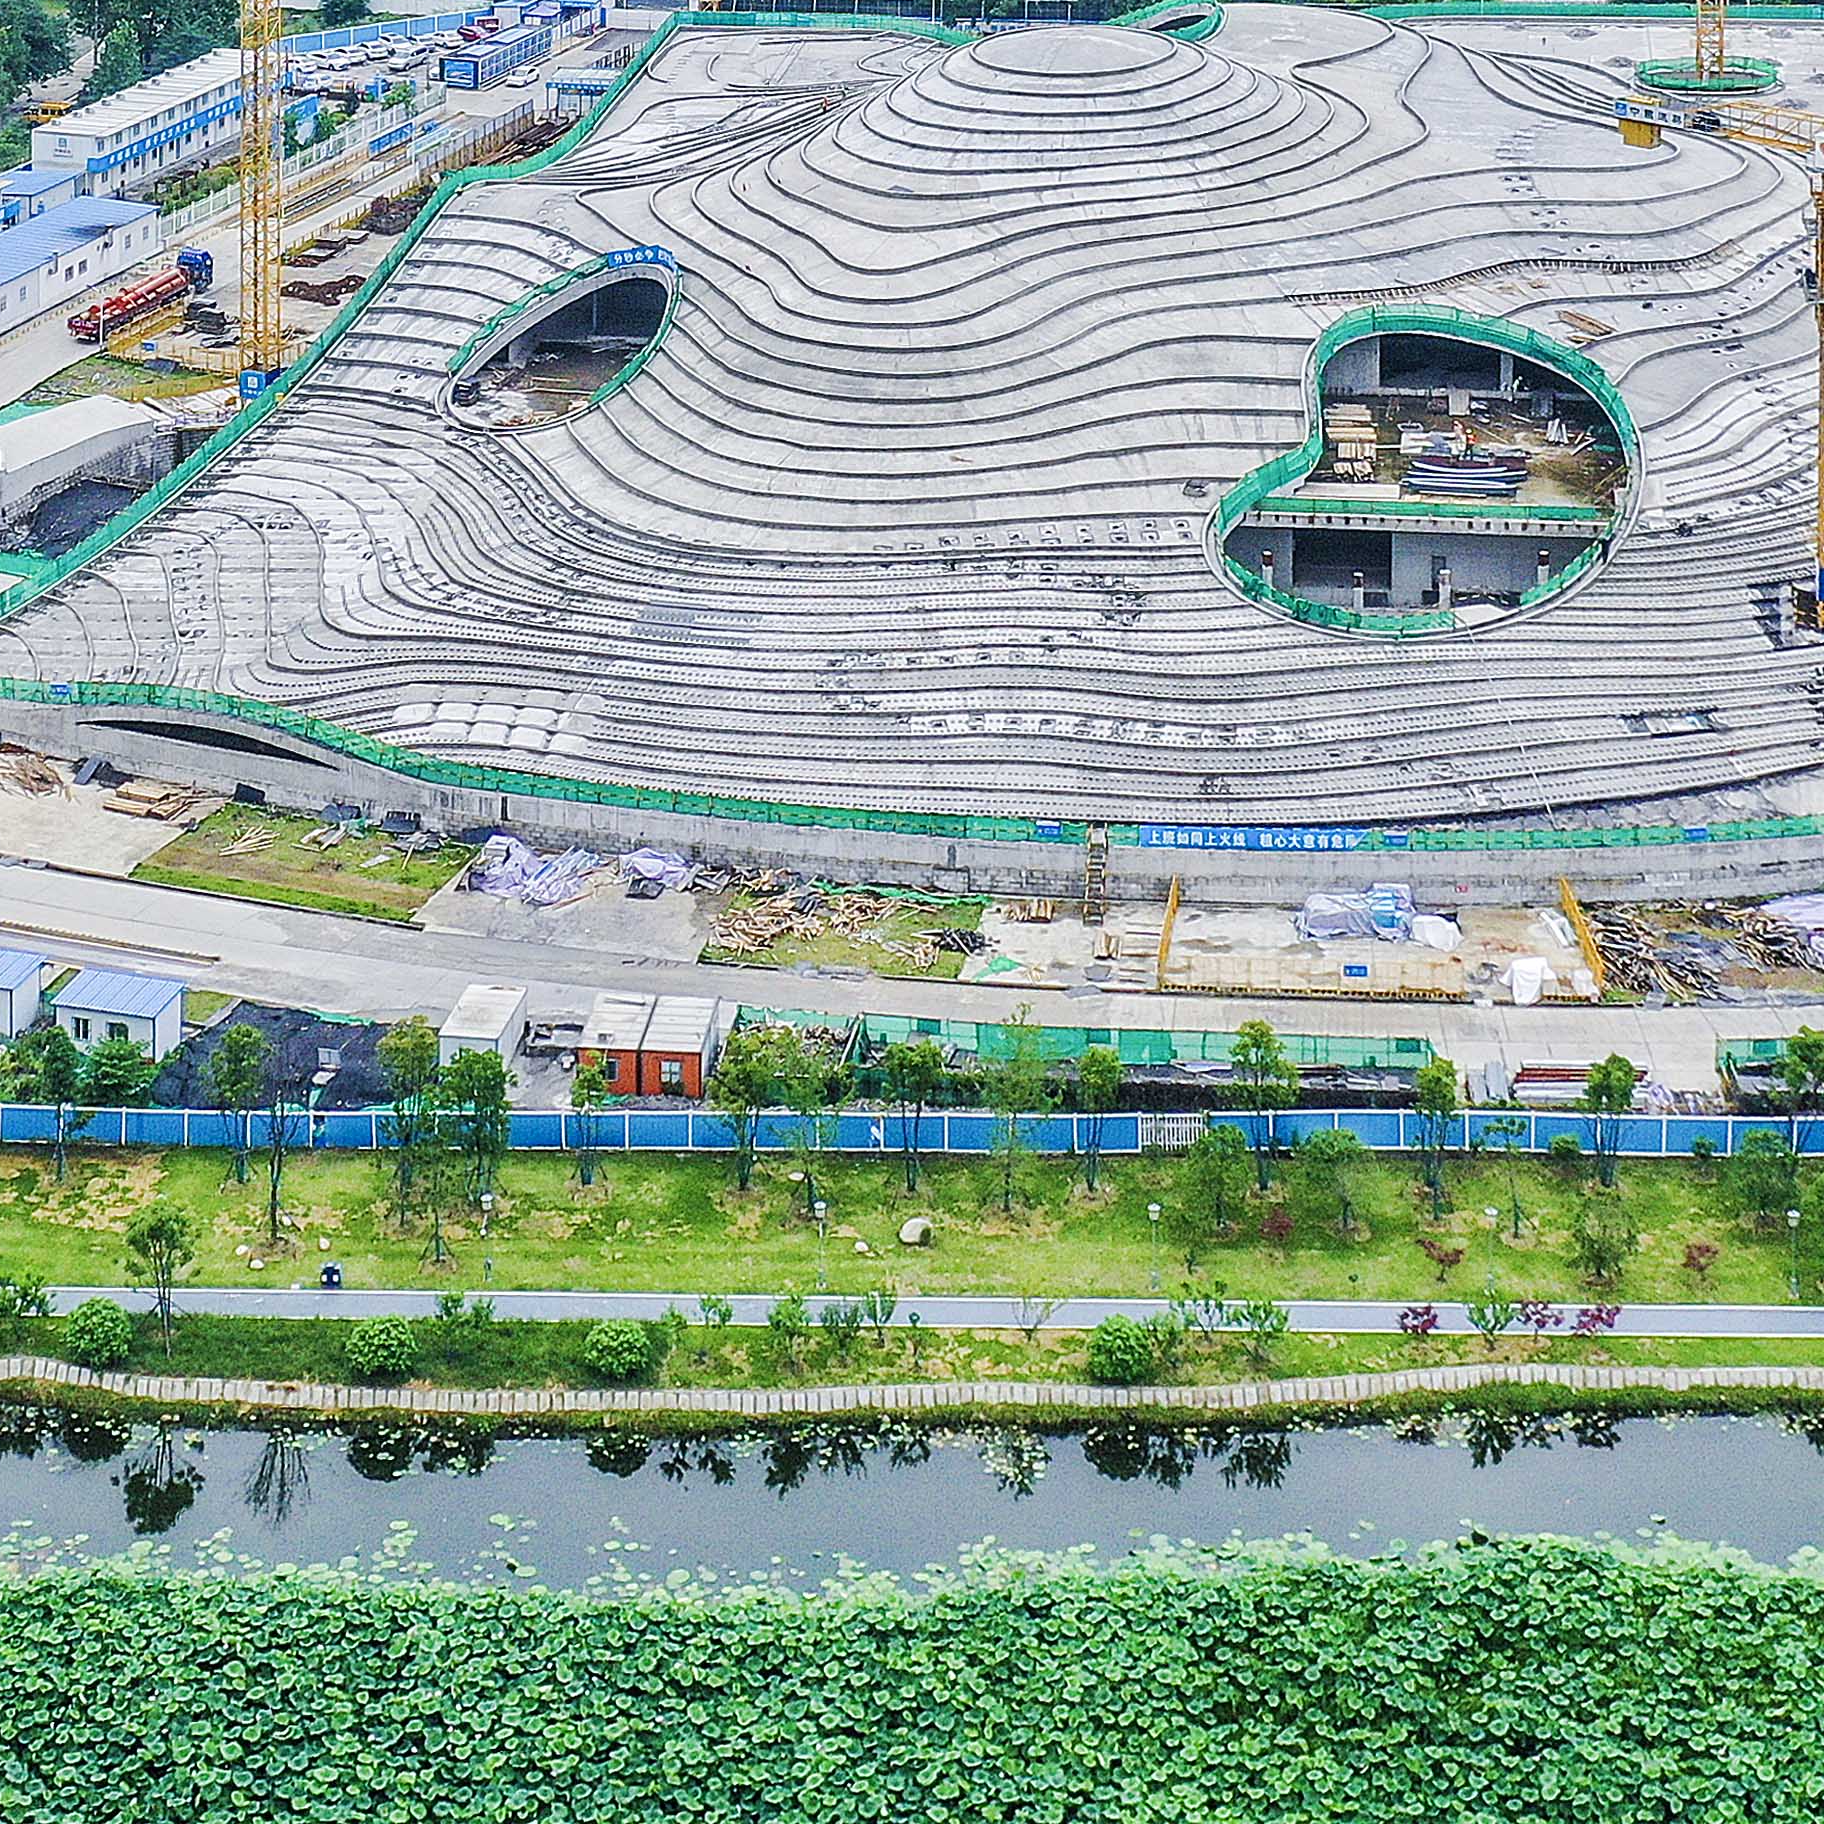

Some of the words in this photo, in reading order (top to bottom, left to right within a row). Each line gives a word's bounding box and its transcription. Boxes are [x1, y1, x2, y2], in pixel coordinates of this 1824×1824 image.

[1148, 830, 1246, 847] 上班如同上火线
